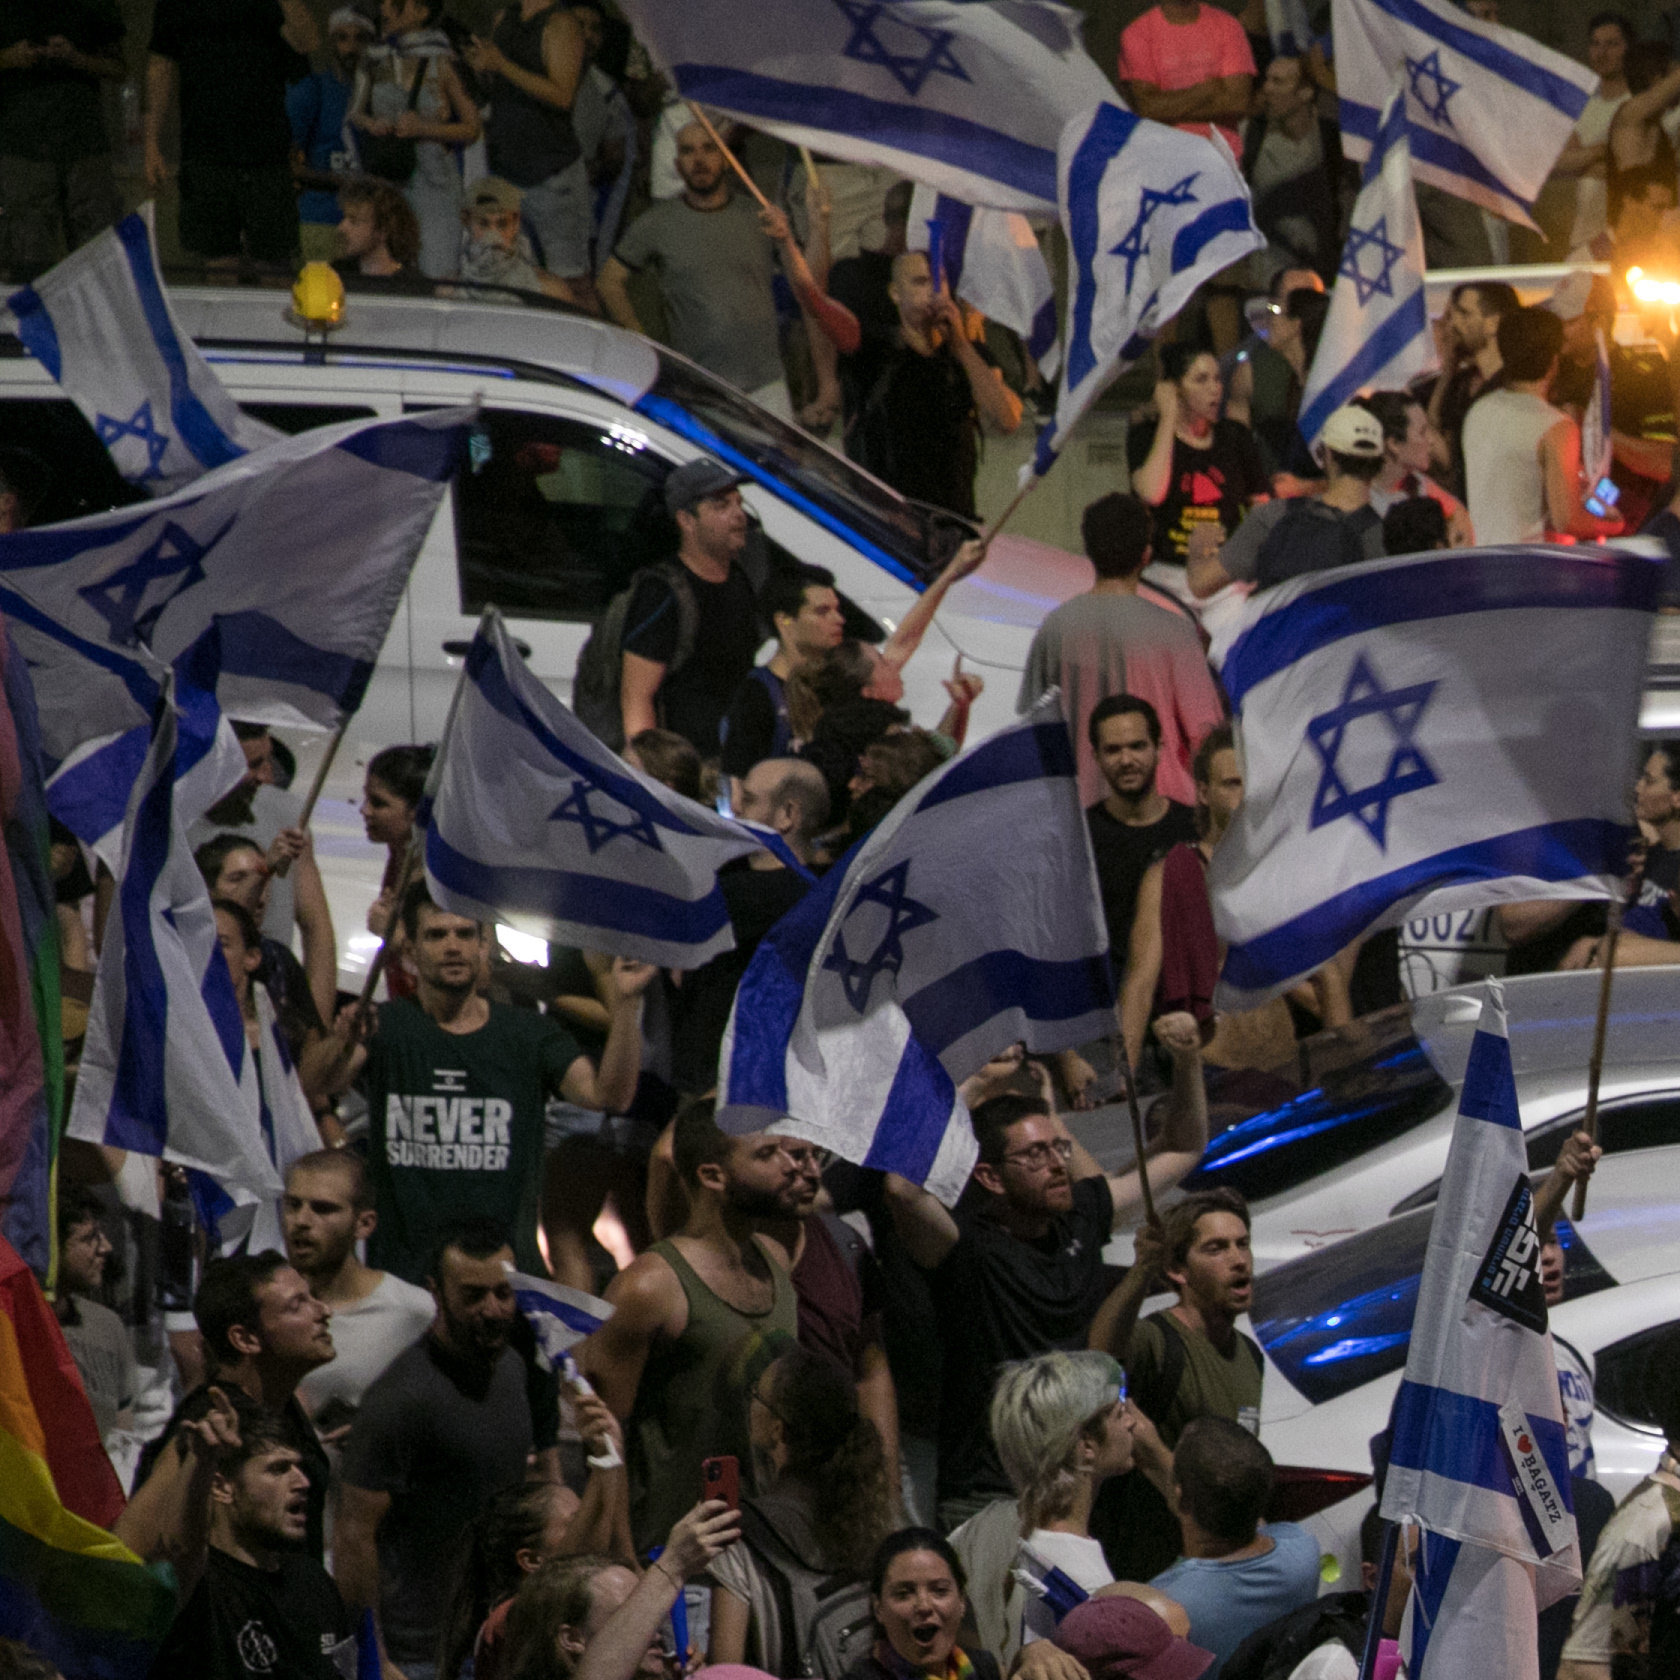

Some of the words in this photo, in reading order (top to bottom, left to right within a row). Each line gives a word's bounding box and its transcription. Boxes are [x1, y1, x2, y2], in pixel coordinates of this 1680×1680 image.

[386, 1093, 513, 1144] NEVER
[386, 1140, 511, 1170] SURRENDER
[1512, 1424, 1523, 1436] I
[1521, 1455, 1564, 1524] BAGATZ
